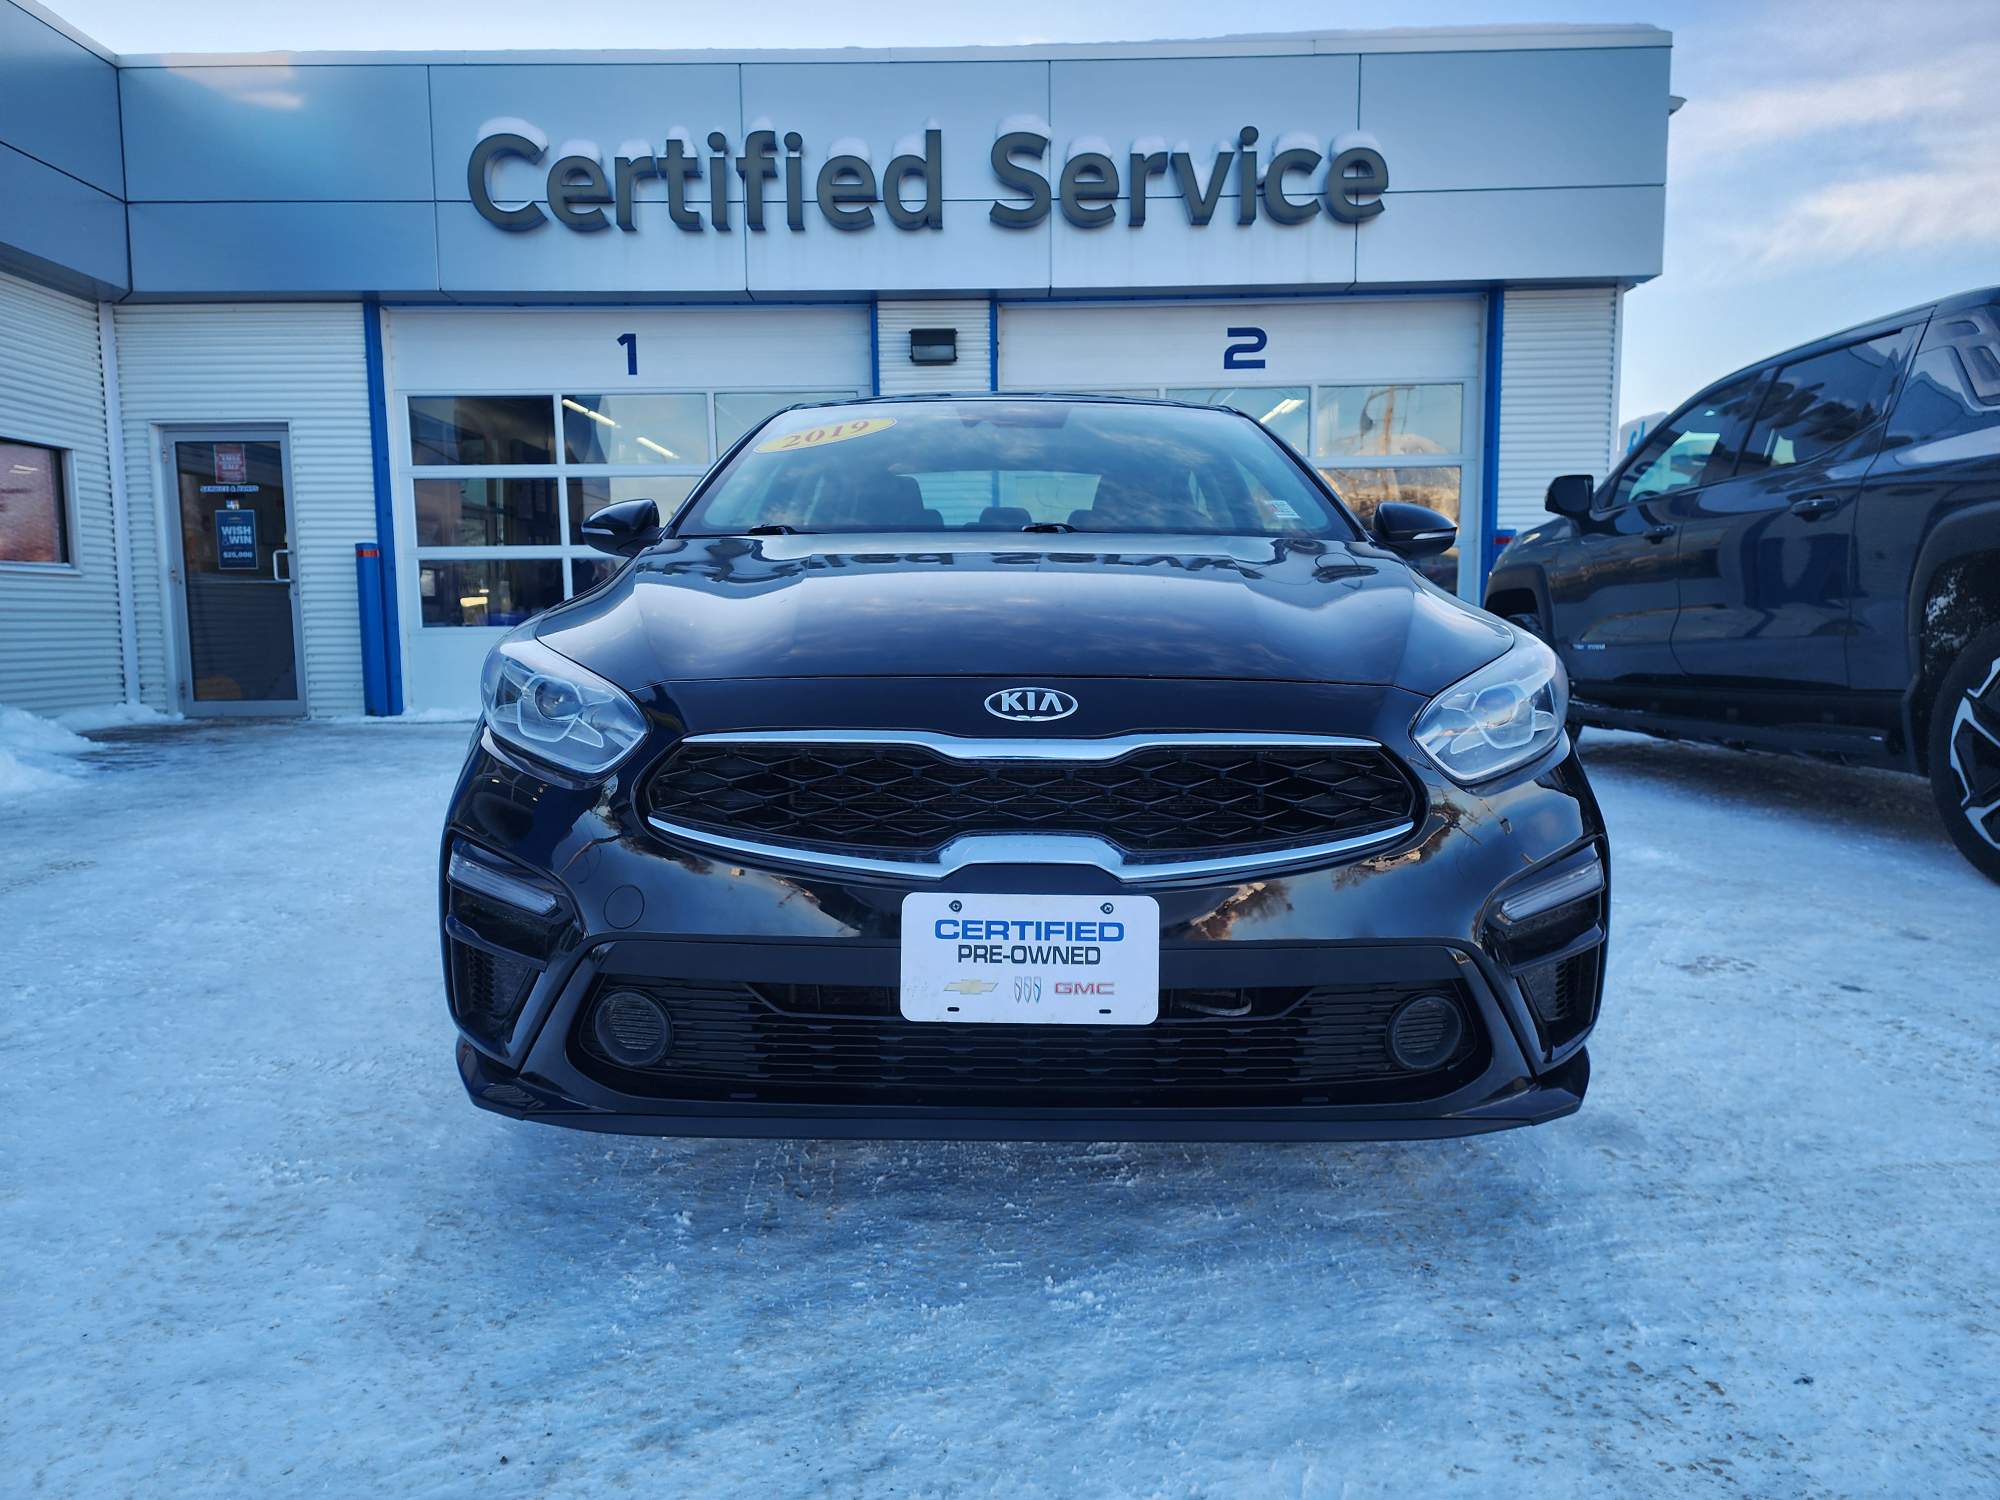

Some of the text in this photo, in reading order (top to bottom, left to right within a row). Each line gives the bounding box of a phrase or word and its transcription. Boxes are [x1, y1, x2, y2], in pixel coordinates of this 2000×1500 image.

[467, 125, 1390, 232] Certified Service
[616, 333, 638, 375] 1
[1223, 327, 1267, 369] 2
[782, 420, 870, 448] 2019
[221, 526, 252, 535] WISH
[229, 535, 252, 544] WIN
[1000, 691, 1064, 712] KIA
[934, 919, 1125, 942] CERTIFIED
[957, 944, 1101, 965] PRE-OWNED
[1055, 981, 1115, 995] GMC
